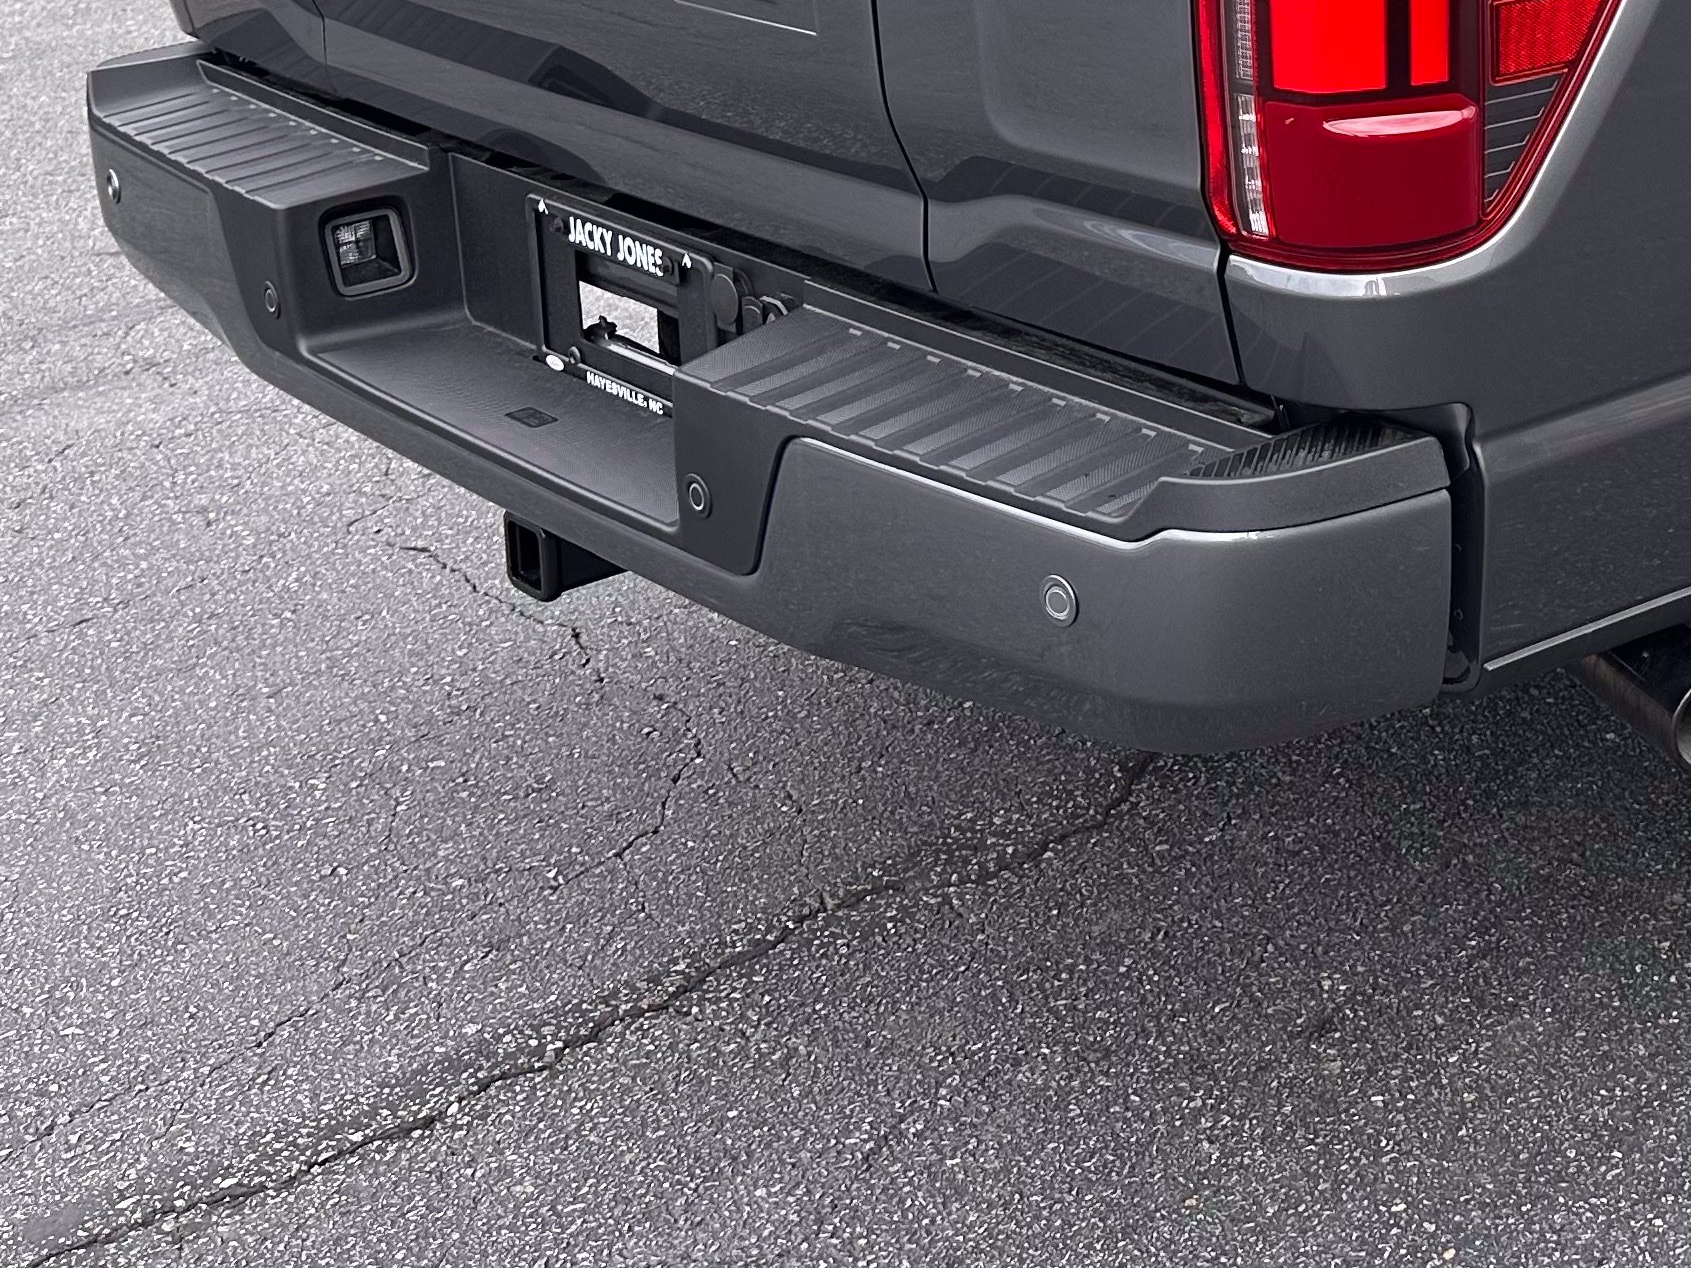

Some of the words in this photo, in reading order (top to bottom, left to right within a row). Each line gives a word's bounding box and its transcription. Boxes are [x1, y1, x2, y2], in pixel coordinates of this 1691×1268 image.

[568, 216, 613, 257] JACKY
[617, 234, 664, 277] JONES
[586, 370, 648, 408] HAYESVILLE,
